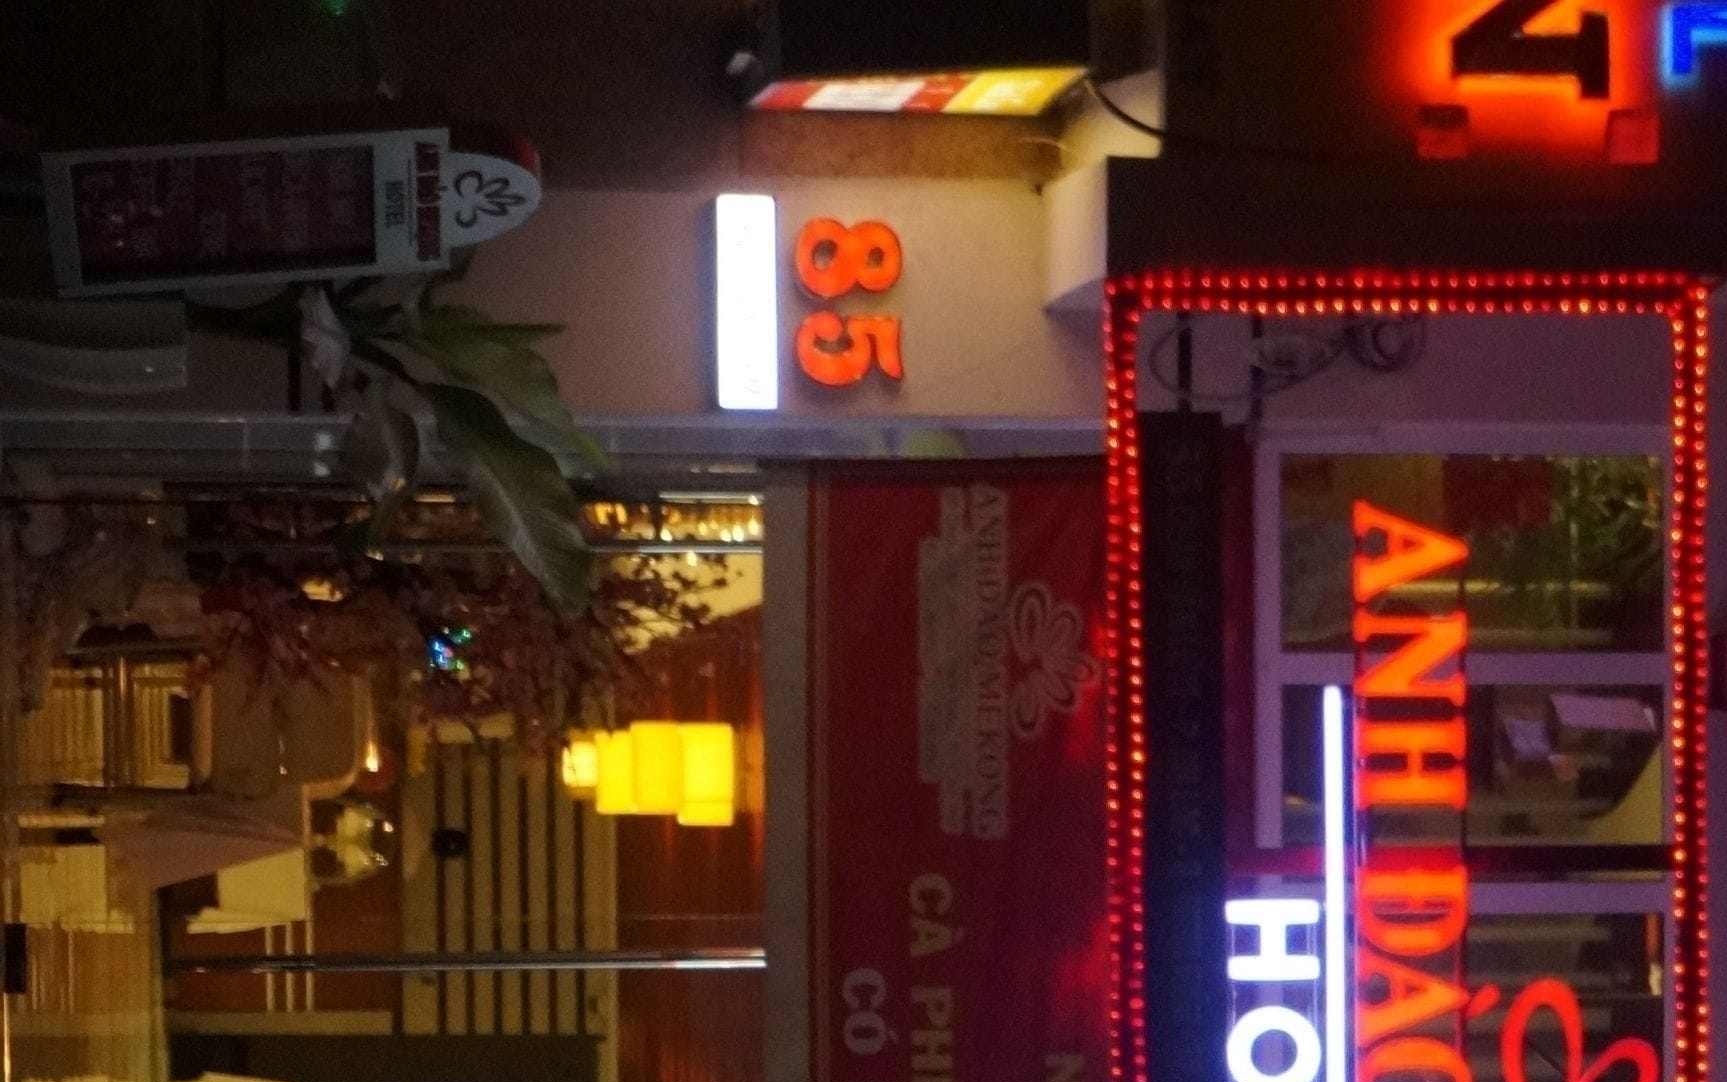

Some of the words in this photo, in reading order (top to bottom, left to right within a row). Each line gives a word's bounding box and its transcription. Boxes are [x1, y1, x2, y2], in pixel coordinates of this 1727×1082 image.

[794, 217, 904, 388] 85
[1352, 501, 1470, 811] ANH
[909, 871, 964, 958] CÀ
[841, 966, 899, 1056] CÓ
